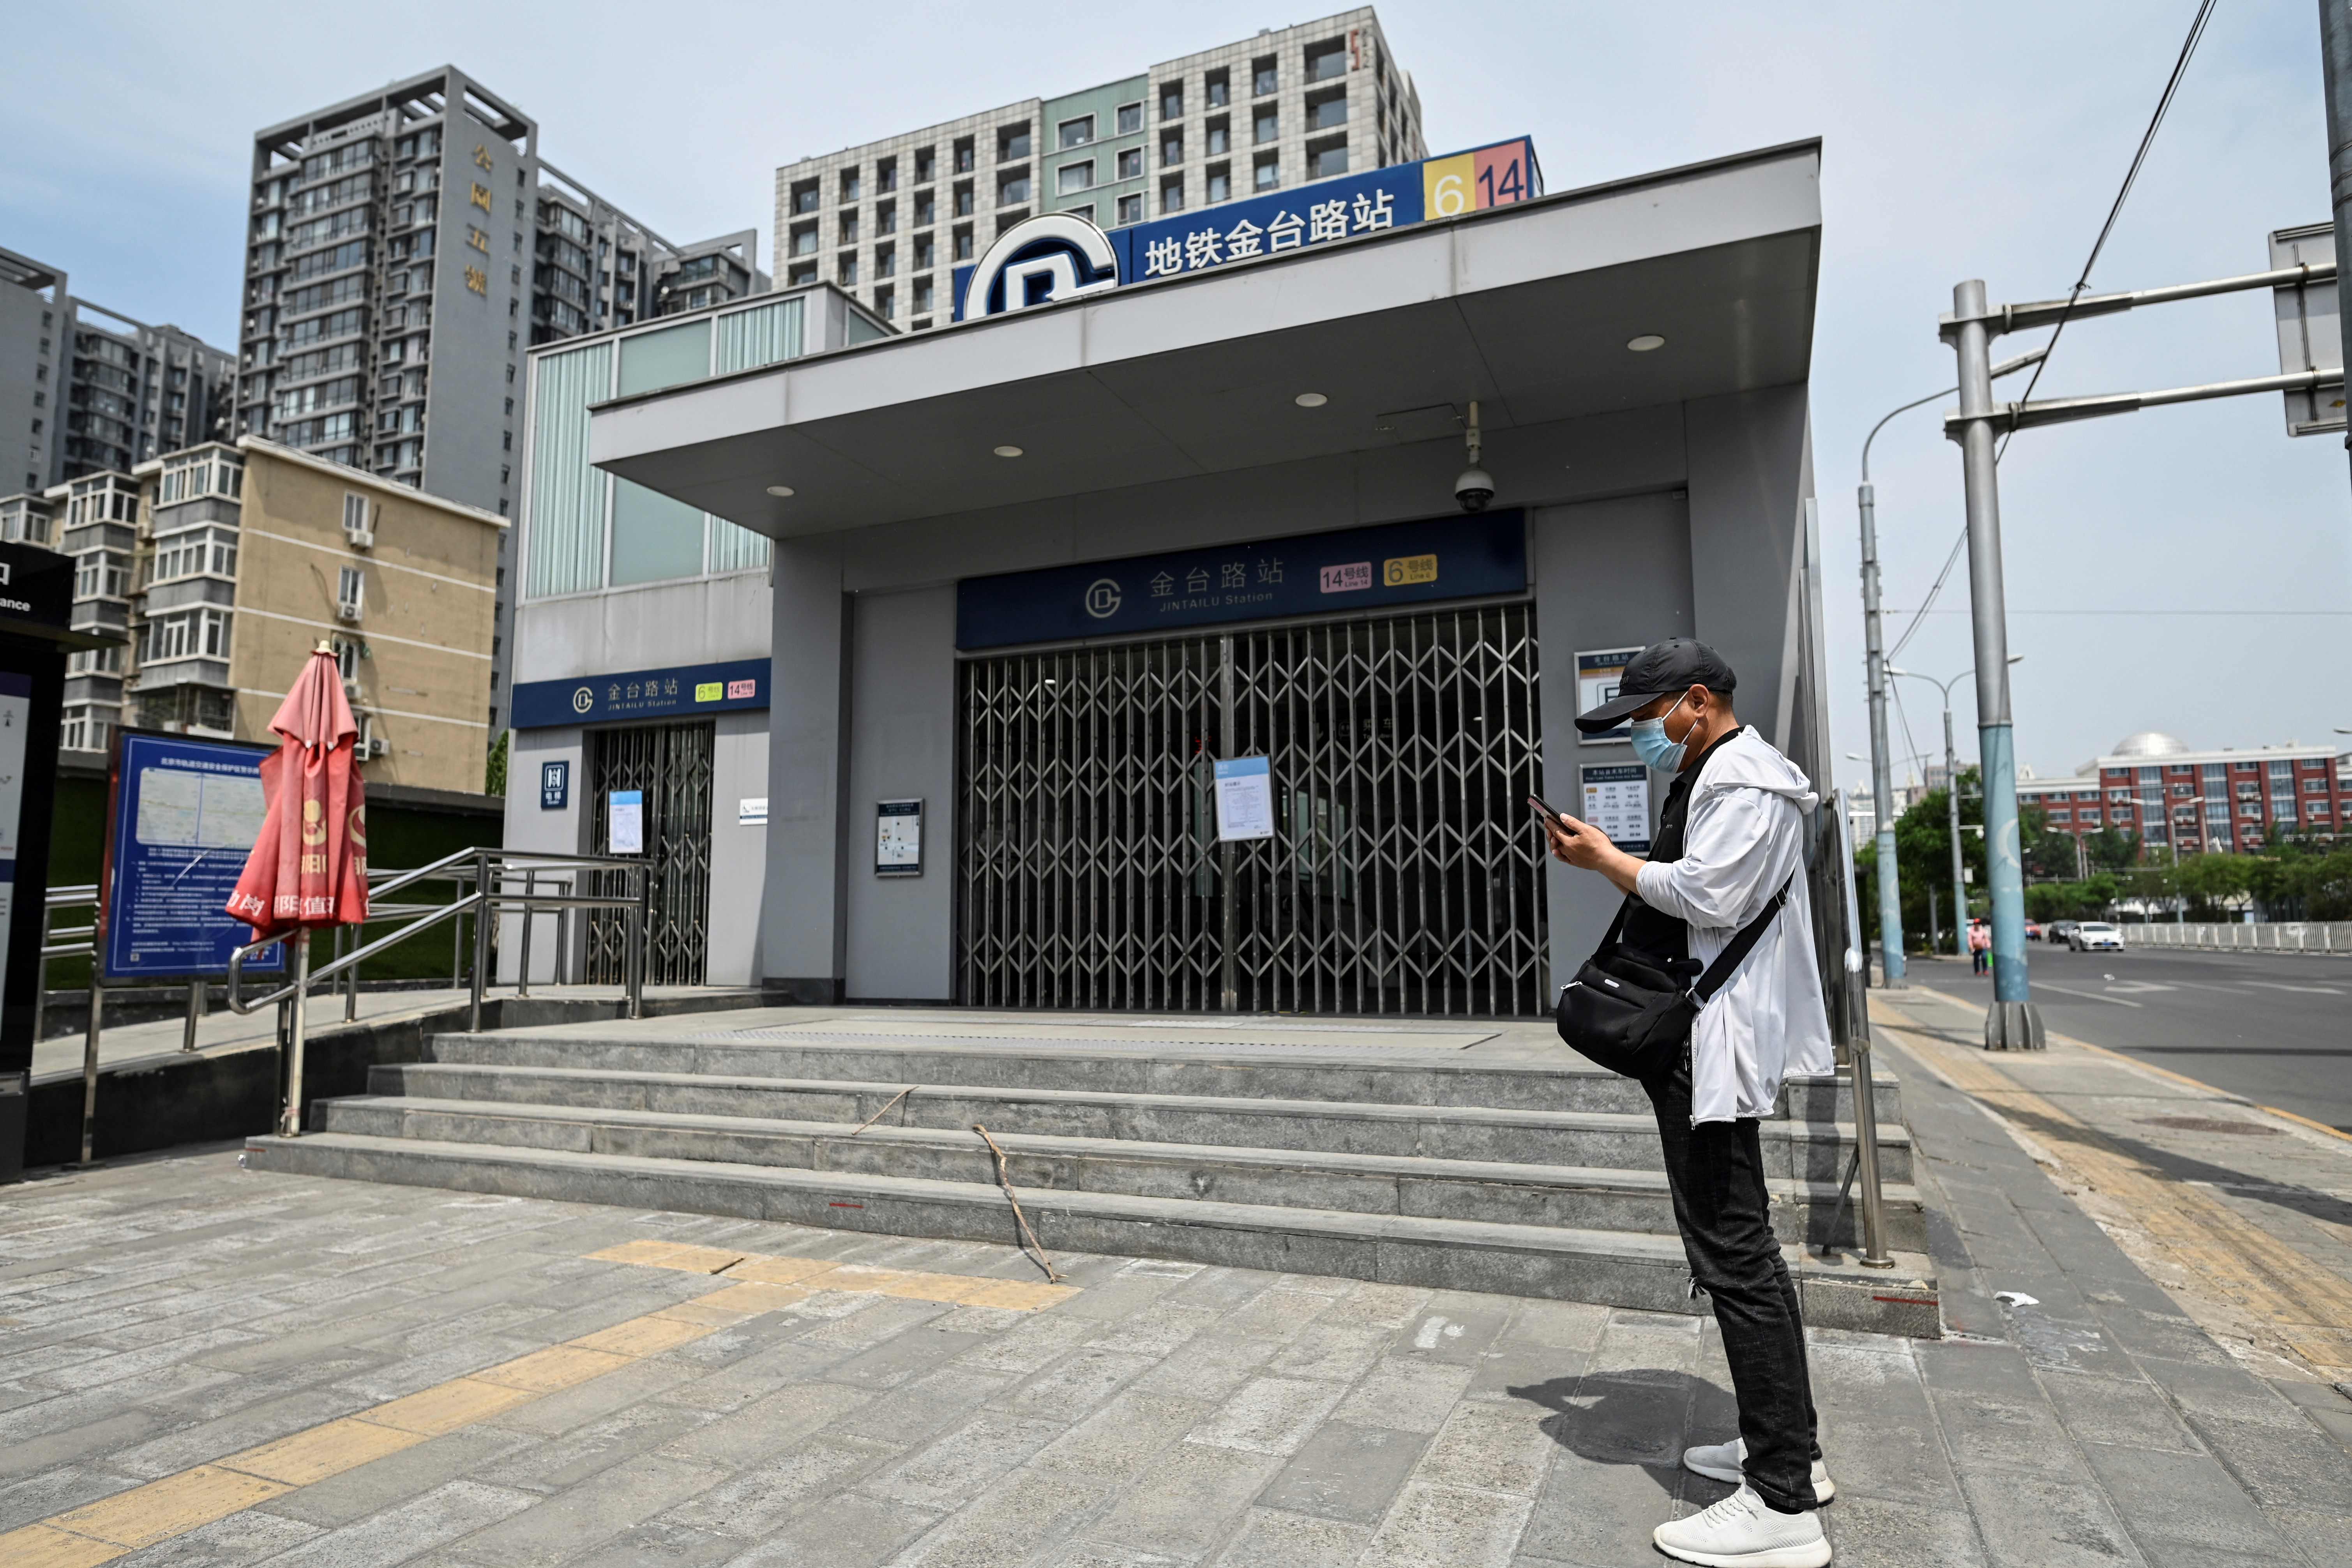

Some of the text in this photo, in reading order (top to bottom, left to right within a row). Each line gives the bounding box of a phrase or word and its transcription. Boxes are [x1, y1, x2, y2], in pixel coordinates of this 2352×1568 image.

[1434, 159, 1524, 217] 6 14
[1144, 189, 1394, 277] 地铁金台路站
[1150, 557, 1284, 597] 金台路站
[1160, 592, 1273, 612] JINTAILU Station
[608, 677, 679, 701] 金台路站
